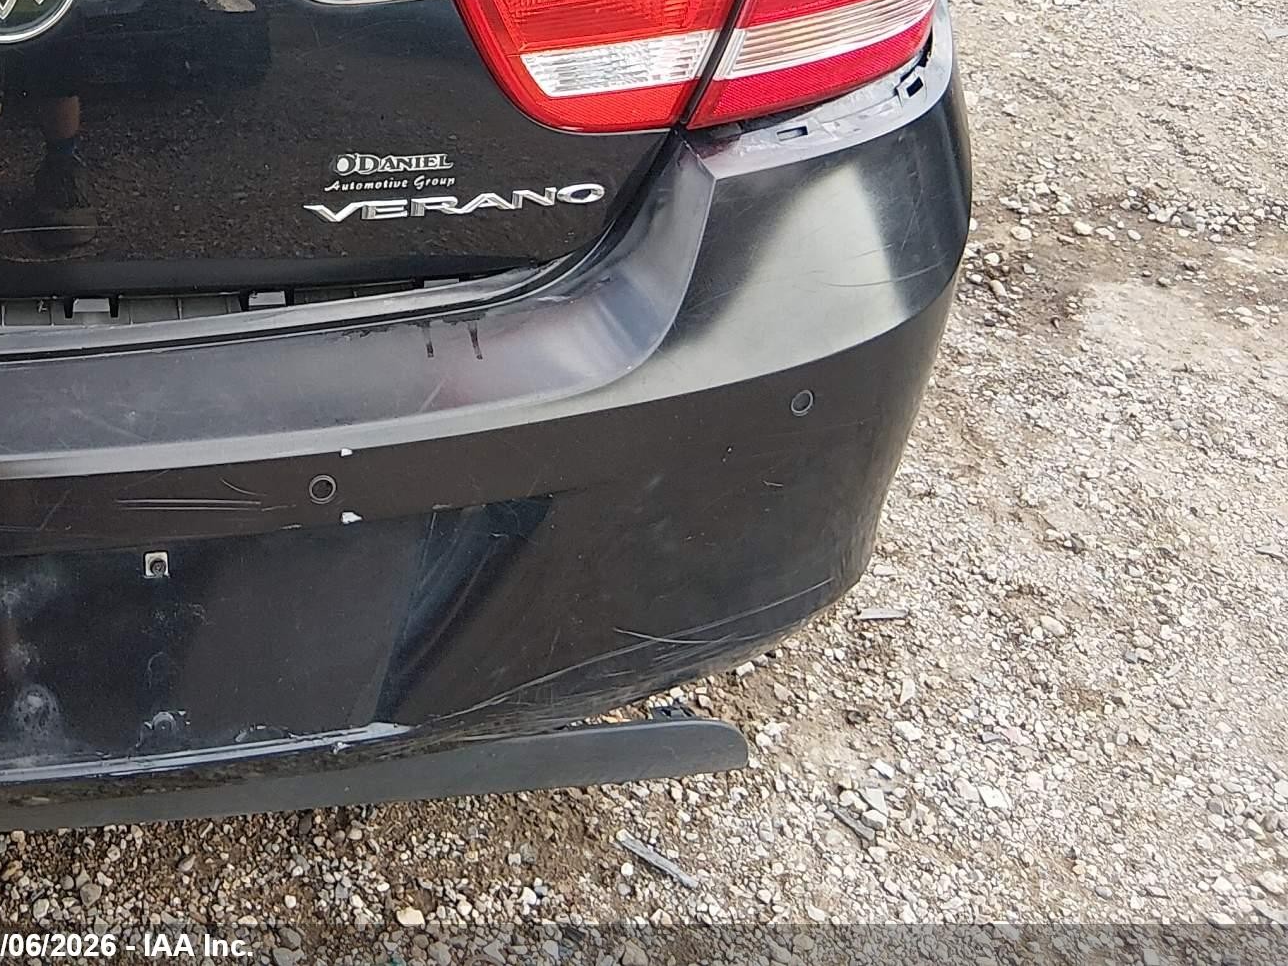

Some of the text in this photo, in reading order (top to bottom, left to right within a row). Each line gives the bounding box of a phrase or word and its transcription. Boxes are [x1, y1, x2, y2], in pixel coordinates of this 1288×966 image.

[324, 174, 456, 192] Automotive Group
[303, 183, 606, 223] VERANO
